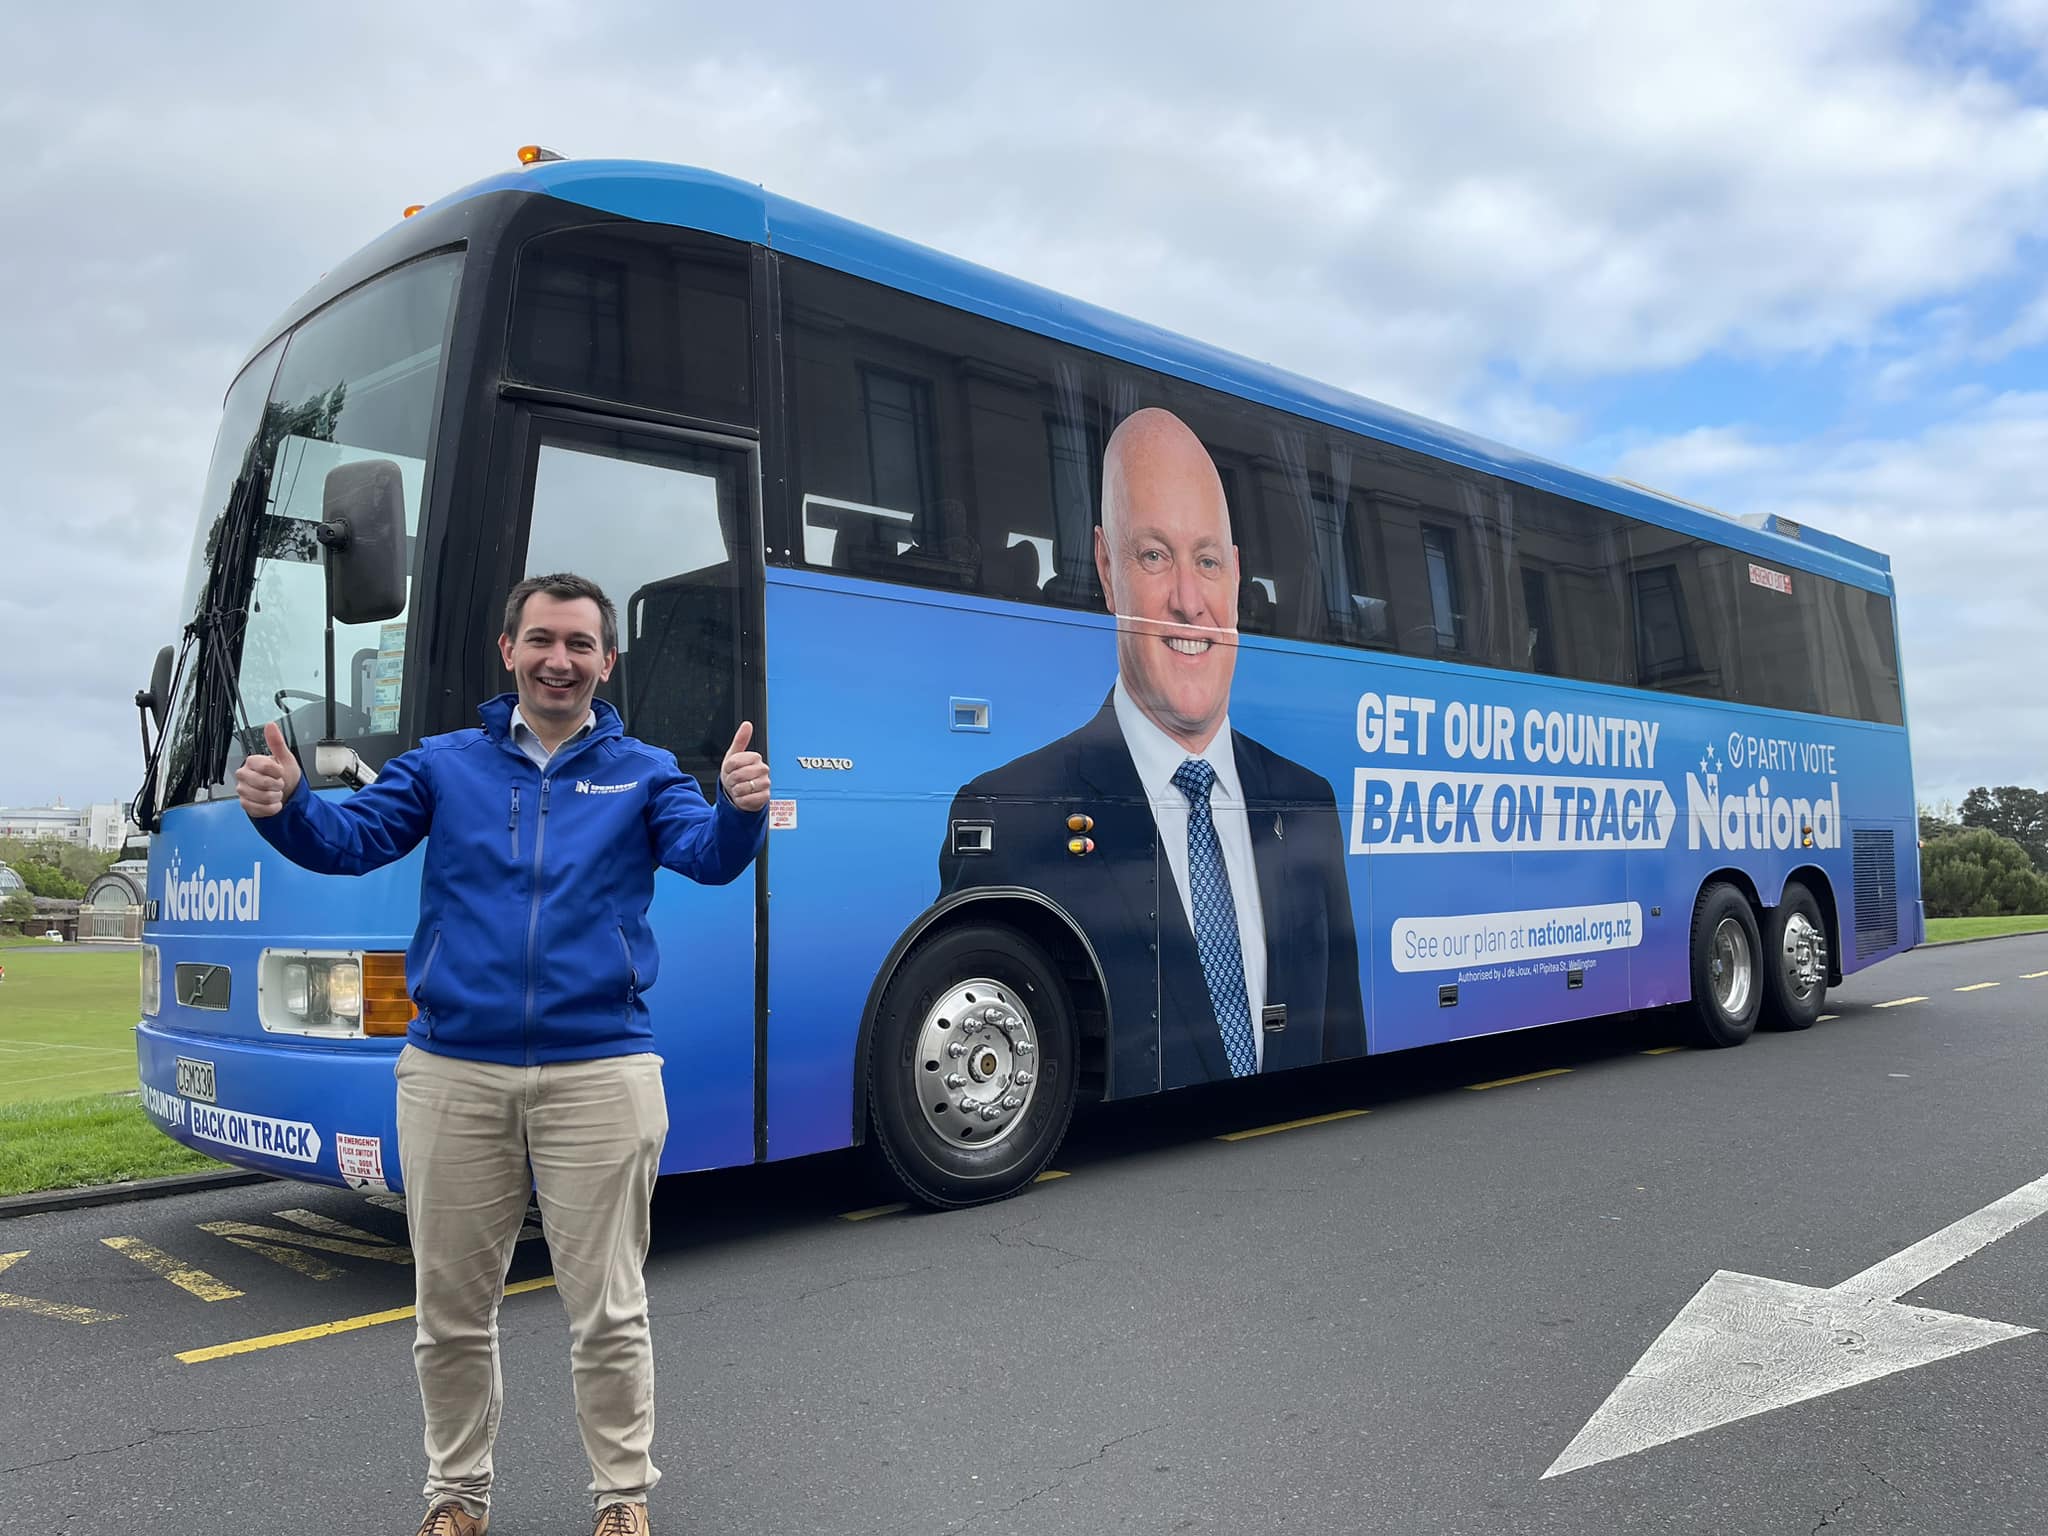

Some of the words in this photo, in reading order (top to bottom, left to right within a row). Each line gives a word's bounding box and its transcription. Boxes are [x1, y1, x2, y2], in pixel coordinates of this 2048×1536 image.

[1356, 692, 1436, 755] GET
[1444, 701, 1515, 761] OUR
[1523, 708, 1660, 769] COUNTRY
[797, 756, 854, 770] VOLVO
[1747, 736, 1797, 771] PARTY
[1800, 743, 1838, 775] VOTE
[1361, 779, 1484, 845] BACK
[1491, 783, 1544, 841] ON
[1553, 786, 1663, 841] TRACK
[1686, 771, 1841, 851] National
[164, 862, 261, 921] National
[1405, 930, 1438, 959] See
[1443, 934, 1471, 957] our
[1474, 926, 1506, 960] plan
[1510, 923, 1525, 949] at
[1528, 917, 1632, 947] national.org.nz
[1458, 969, 1493, 983] Authorised
[1493, 969, 1501, 982] by
[177, 1062, 214, 1098] CGM330
[149, 1086, 186, 1125] COUNTRY
[193, 1107, 227, 1141] BACK
[229, 1115, 249, 1145] ON
[251, 1121, 312, 1158] TRACK
[344, 1136, 378, 1147] EMERGENCY
